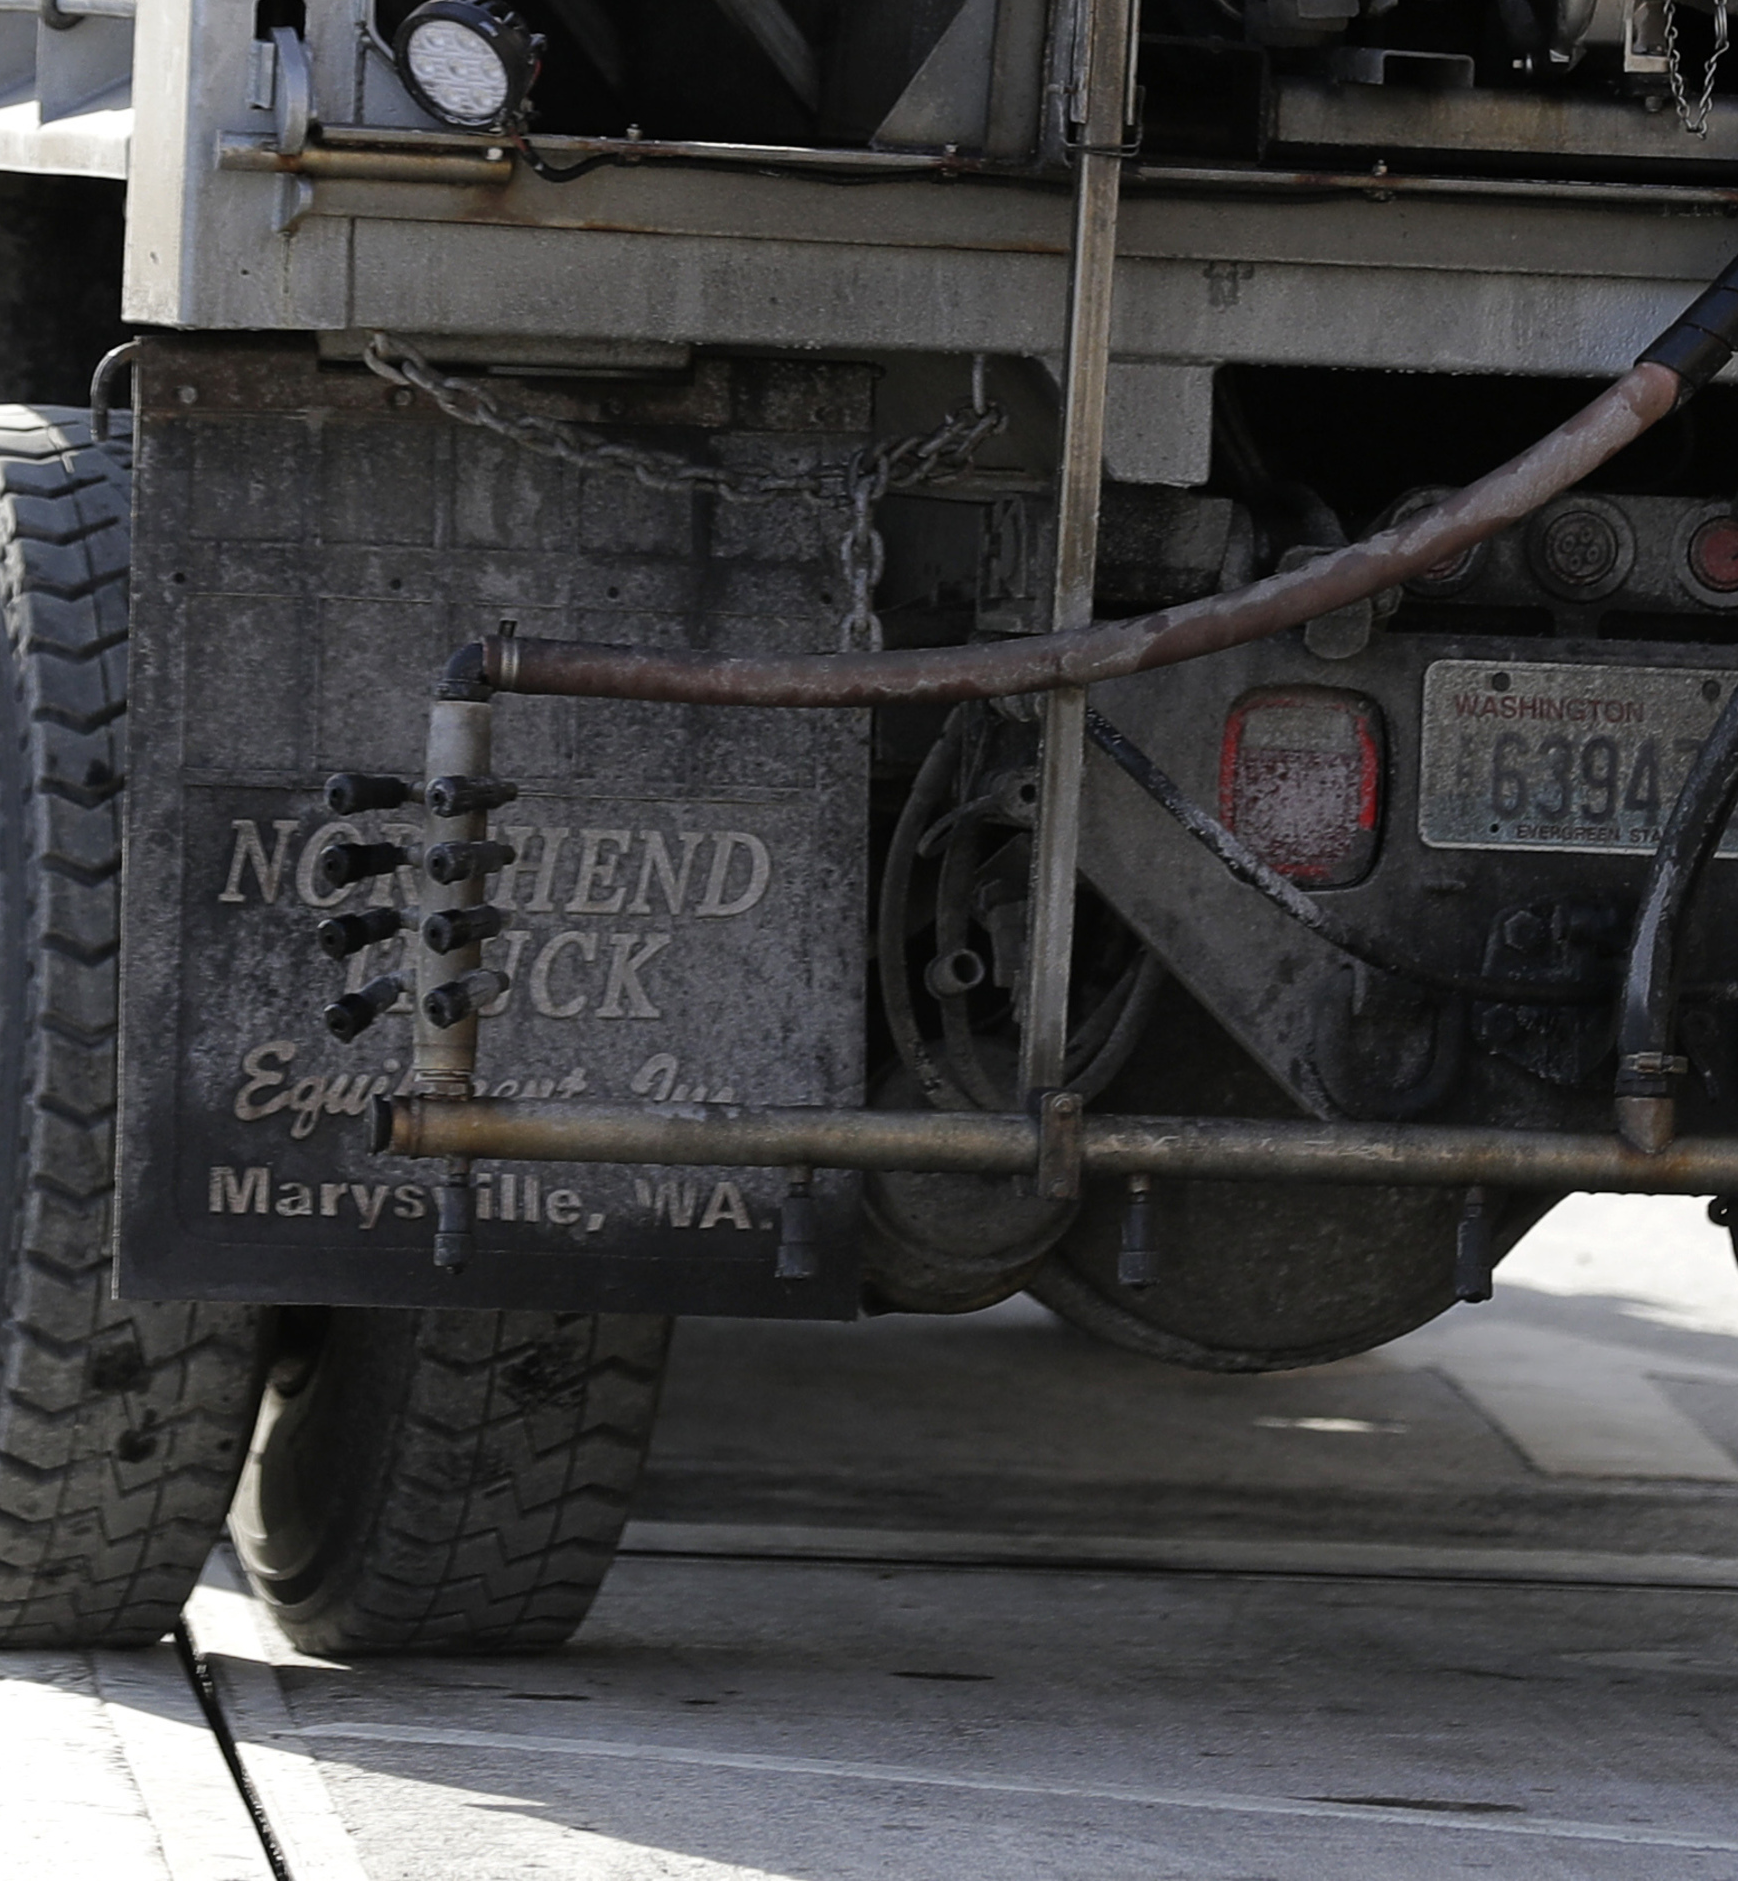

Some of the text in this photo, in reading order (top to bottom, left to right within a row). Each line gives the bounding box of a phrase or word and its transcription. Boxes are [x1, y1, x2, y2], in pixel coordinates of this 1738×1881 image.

[1453, 694, 1645, 724] WASHINGTON
[1516, 824, 1663, 843] EVERGREEN STA
[220, 819, 771, 917] NORHEND
[209, 1165, 609, 1232] Marysille,
